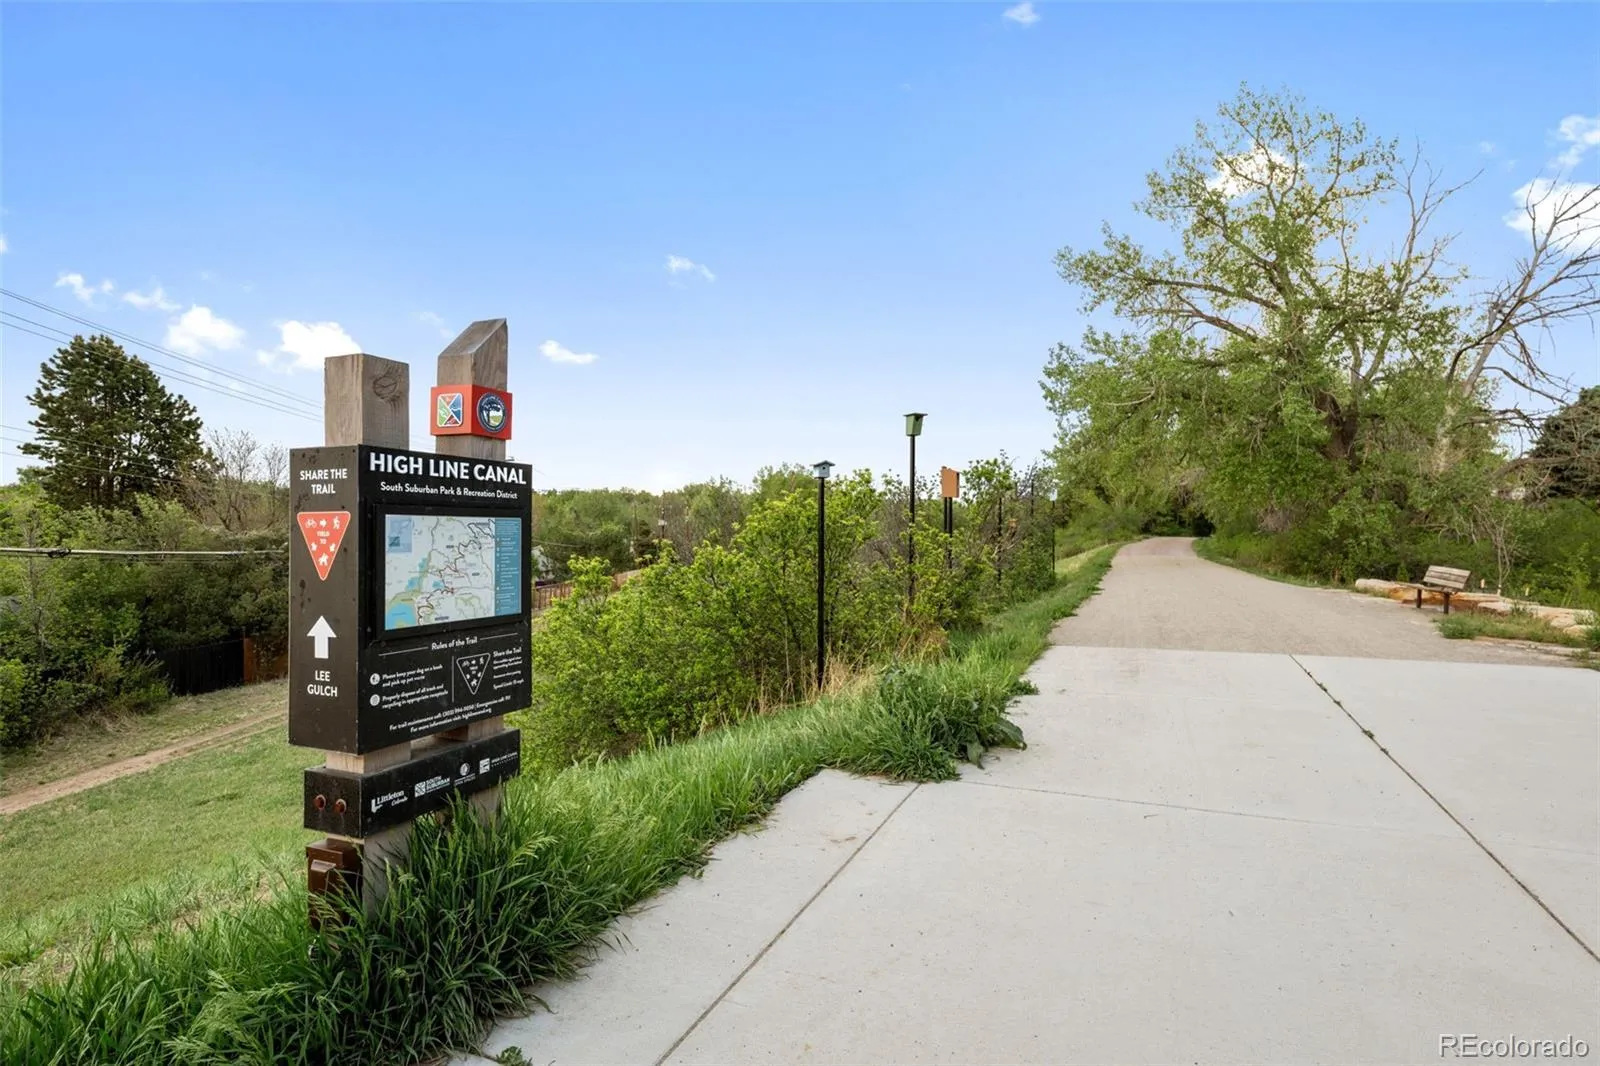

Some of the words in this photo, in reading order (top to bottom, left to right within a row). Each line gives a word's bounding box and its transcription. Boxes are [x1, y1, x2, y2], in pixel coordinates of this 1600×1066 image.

[299, 469, 329, 481] SHARE
[330, 468, 348, 479] THE
[370, 452, 423, 475] HIGH
[429, 458, 470, 479] LINE
[473, 464, 527, 485] CANAL
[311, 483, 336, 495] TRAIL
[380, 481, 403, 492] South
[405, 483, 438, 495] Suburban
[440, 486, 455, 496] Park
[456, 488, 462, 496] &
[463, 487, 496, 498] Recreation
[496, 490, 518, 500] District
[431, 642, 448, 651] Rules
[448, 639, 455, 648] of
[456, 638, 465, 647] the
[466, 635, 478, 645] Trail
[493, 649, 505, 658] Share
[315, 670, 331, 682] LEE
[307, 683, 338, 697] GULCH
[376, 790, 405, 805] Littleton
